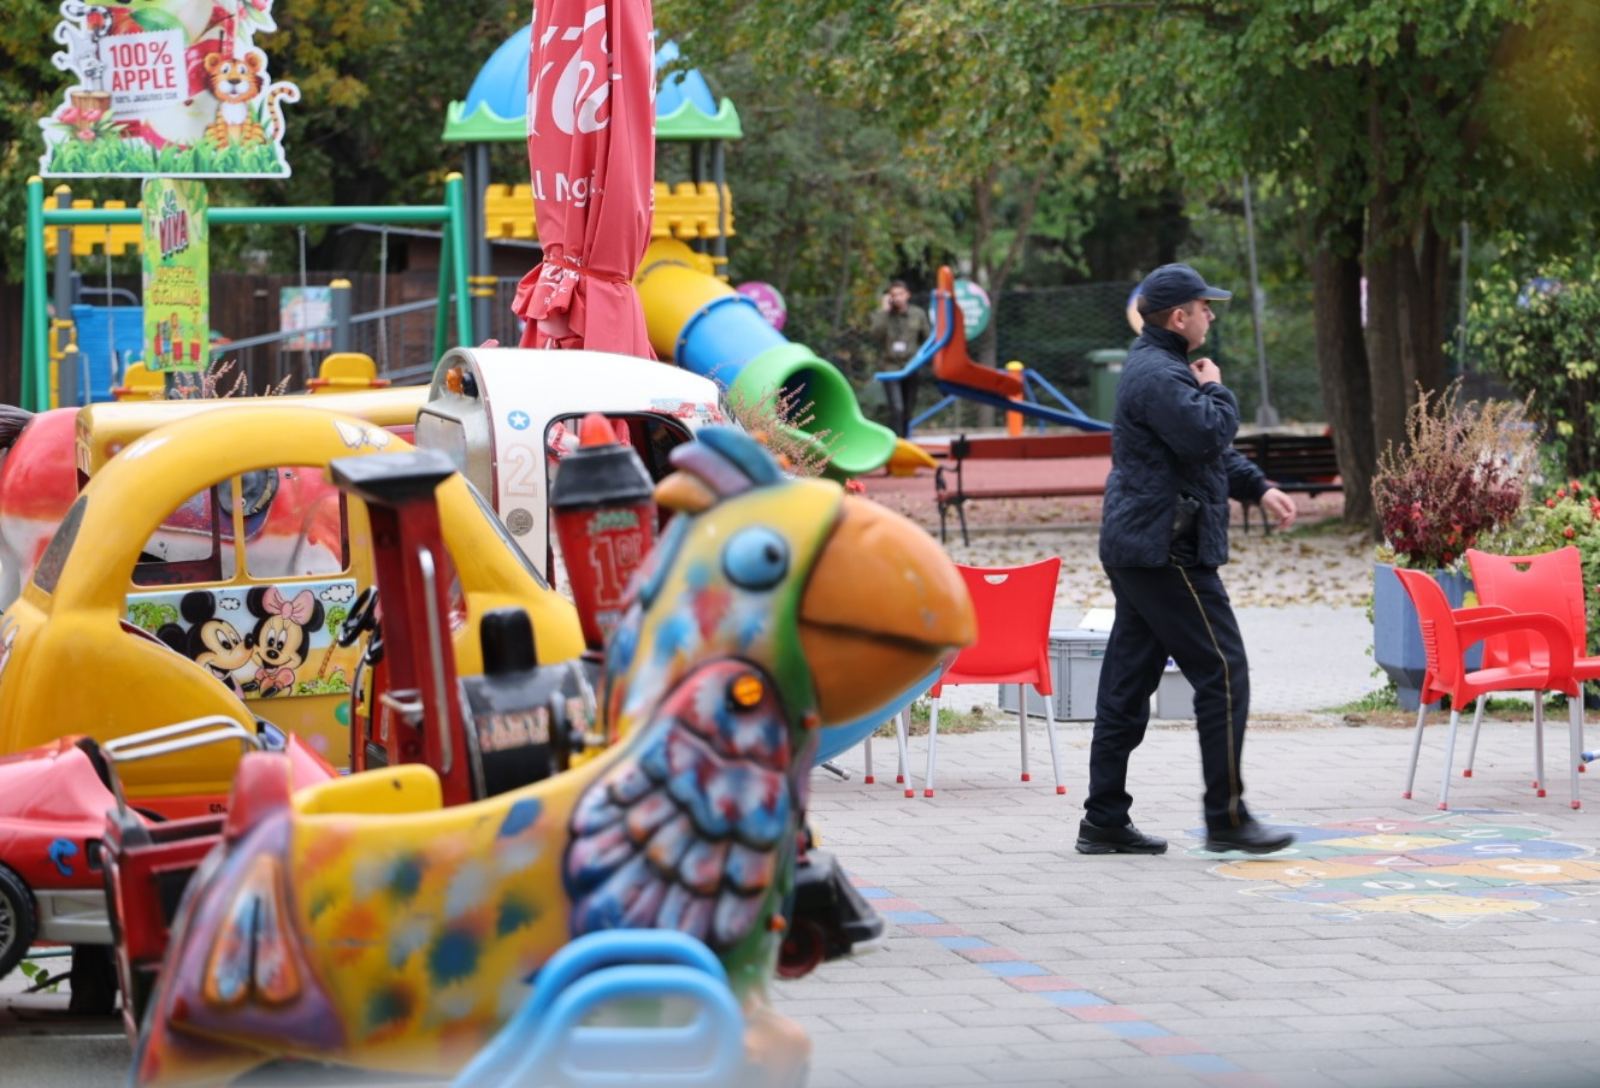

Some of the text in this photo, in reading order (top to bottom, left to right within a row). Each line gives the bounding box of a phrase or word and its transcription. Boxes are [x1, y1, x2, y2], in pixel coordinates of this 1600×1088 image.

[109, 41, 172, 68] 100%
[112, 66, 177, 91] APPLE
[159, 209, 188, 255] VIVA
[503, 443, 538, 497] 2
